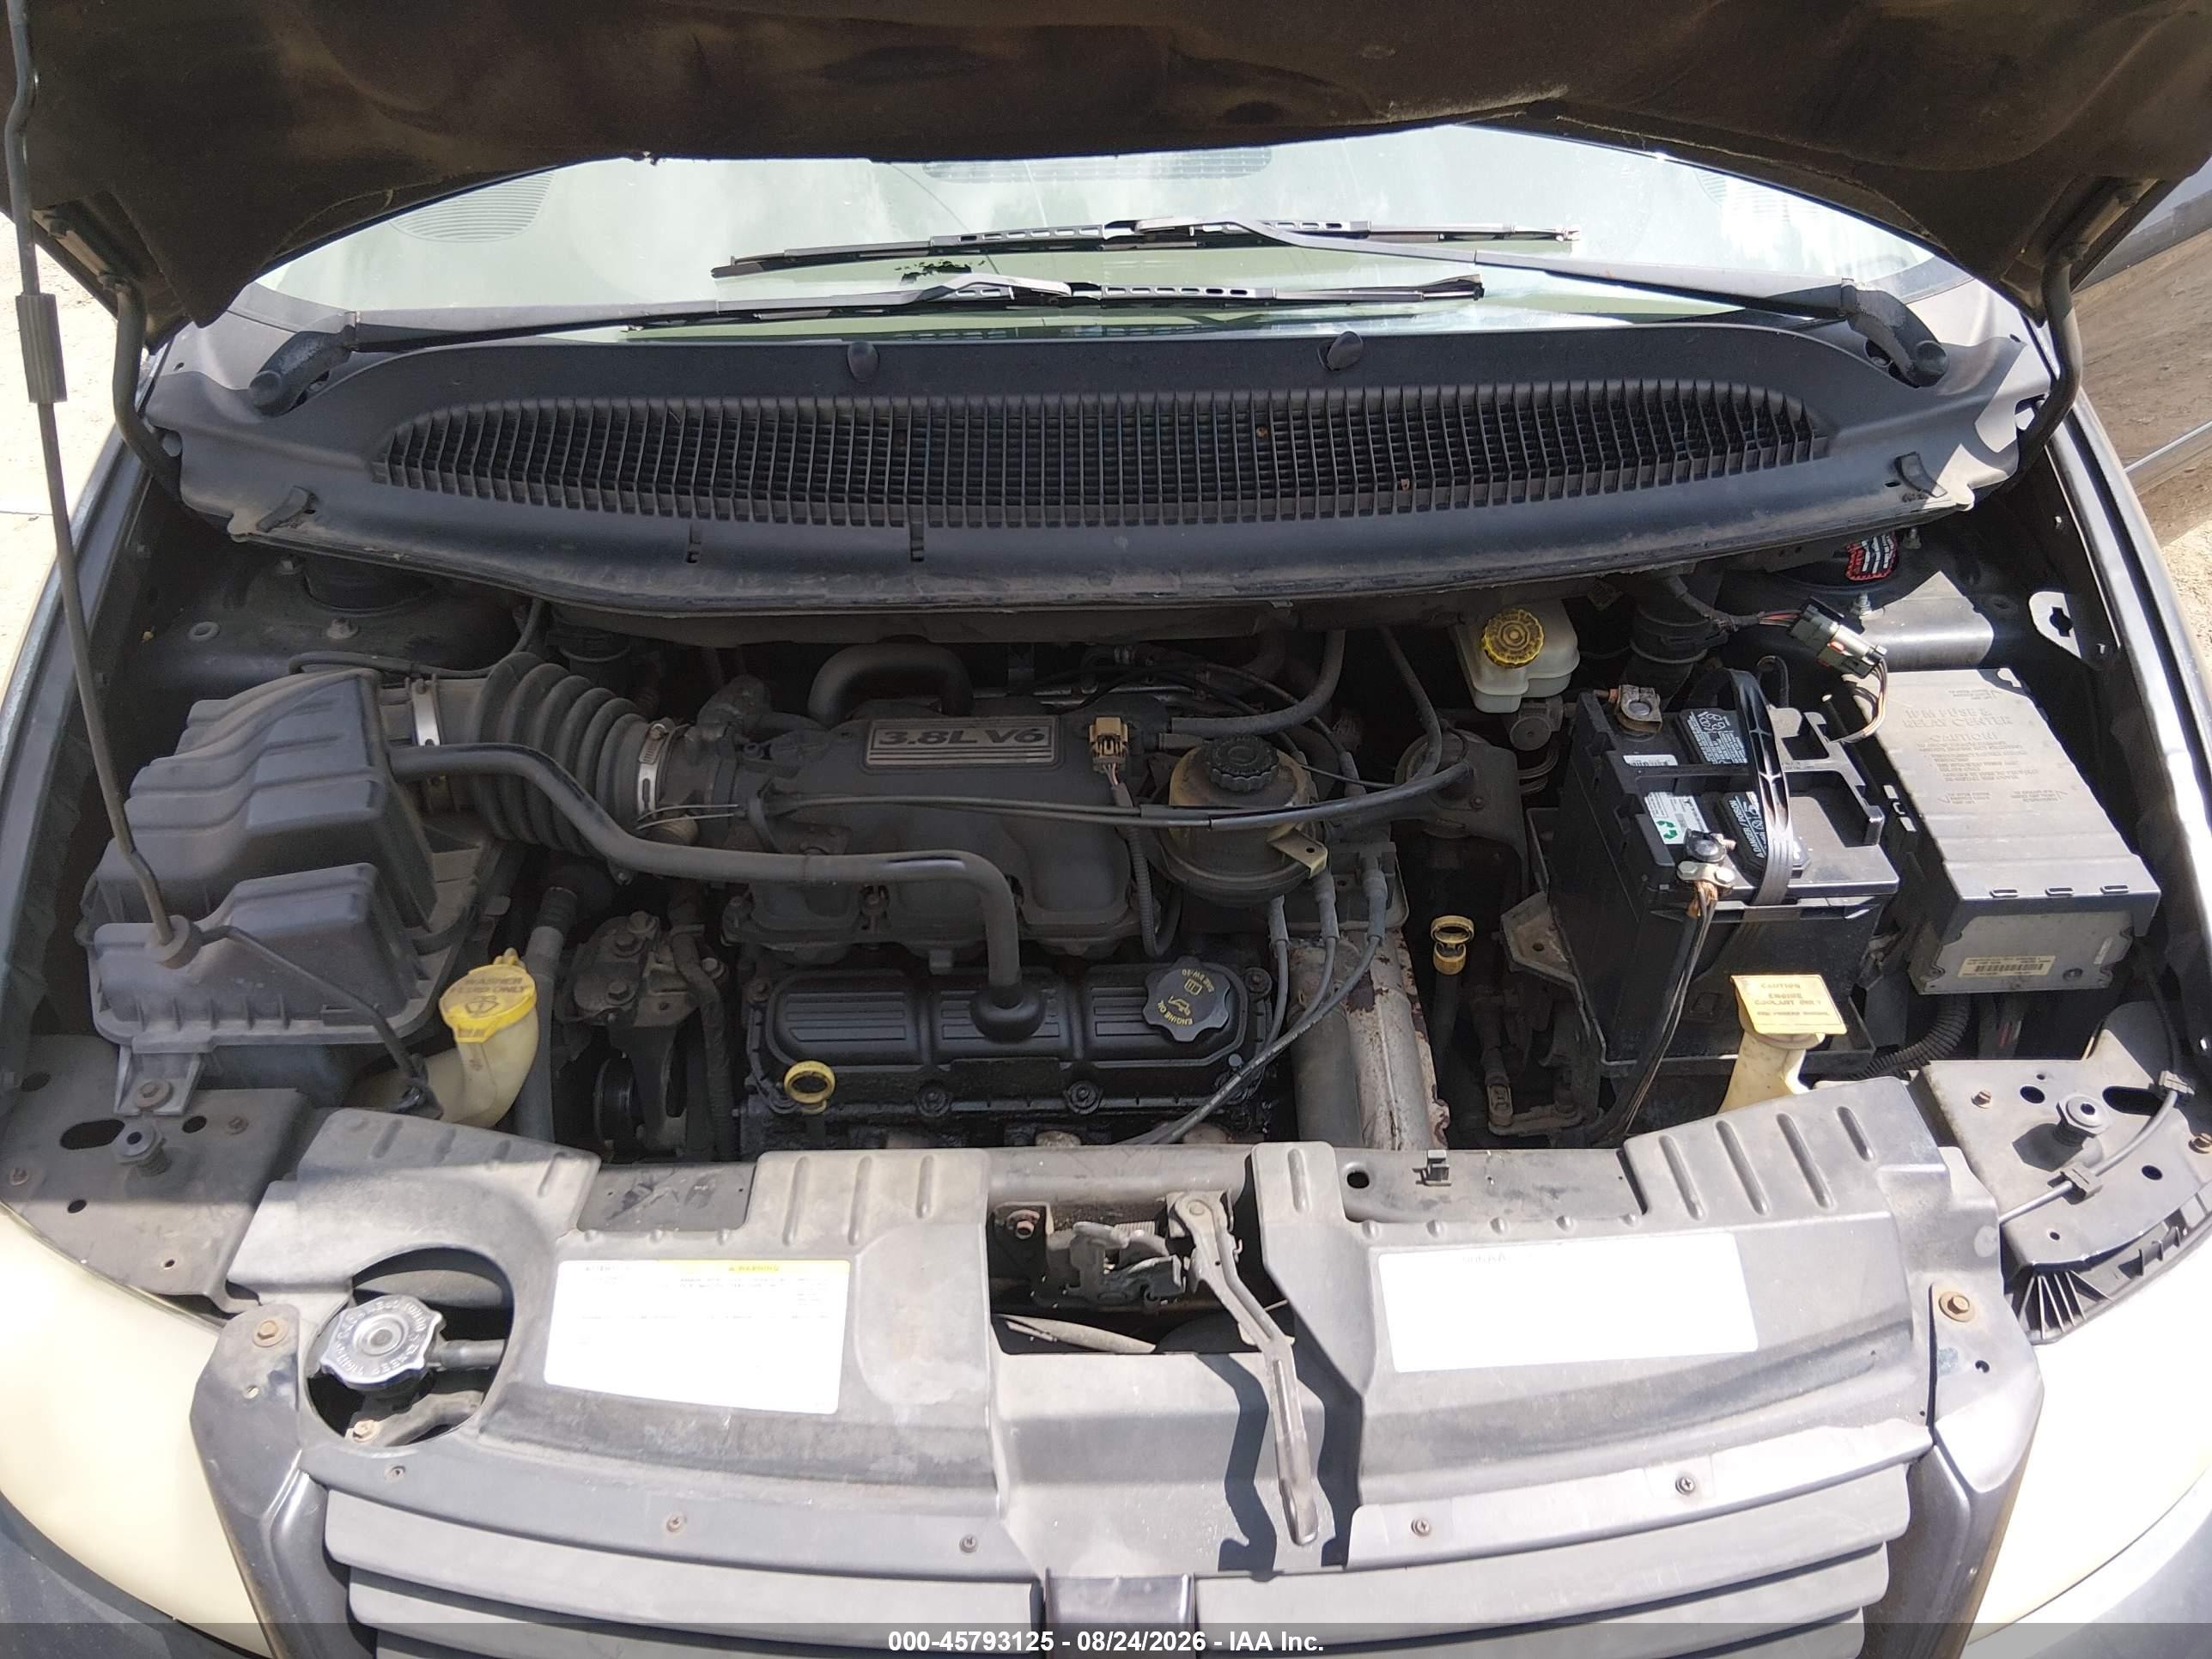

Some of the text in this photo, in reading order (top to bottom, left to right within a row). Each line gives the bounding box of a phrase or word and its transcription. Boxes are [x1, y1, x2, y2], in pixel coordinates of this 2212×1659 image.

[1950, 715, 2014, 727] CENTER
[878, 728, 1045, 745] 3.8L V6
[1164, 1011, 1194, 1025] ENGINE
